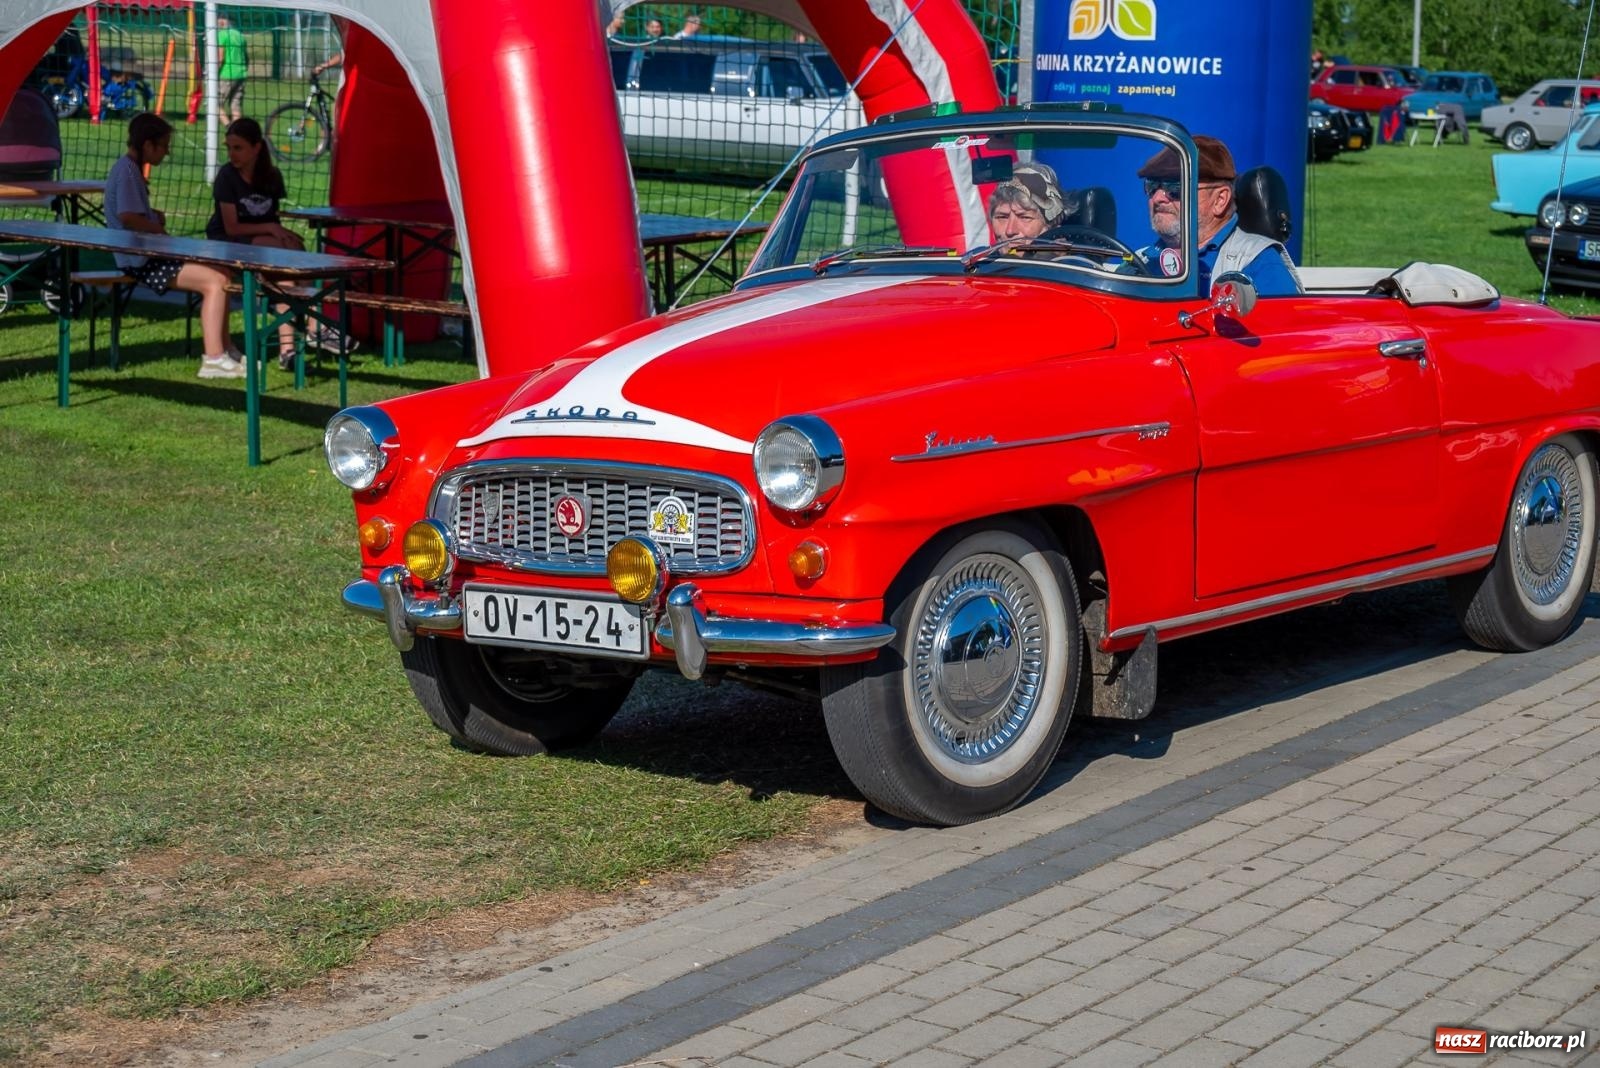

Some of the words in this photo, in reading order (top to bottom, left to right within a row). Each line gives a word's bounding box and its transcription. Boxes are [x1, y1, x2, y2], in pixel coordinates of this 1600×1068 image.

[1036, 53, 1070, 71] GMINA
[1074, 52, 1222, 75] KRZYŻANOWICE
[1081, 84, 1111, 95] poznaj
[1118, 85, 1176, 97] zapamiętaj
[484, 594, 622, 647] OV-15-24
